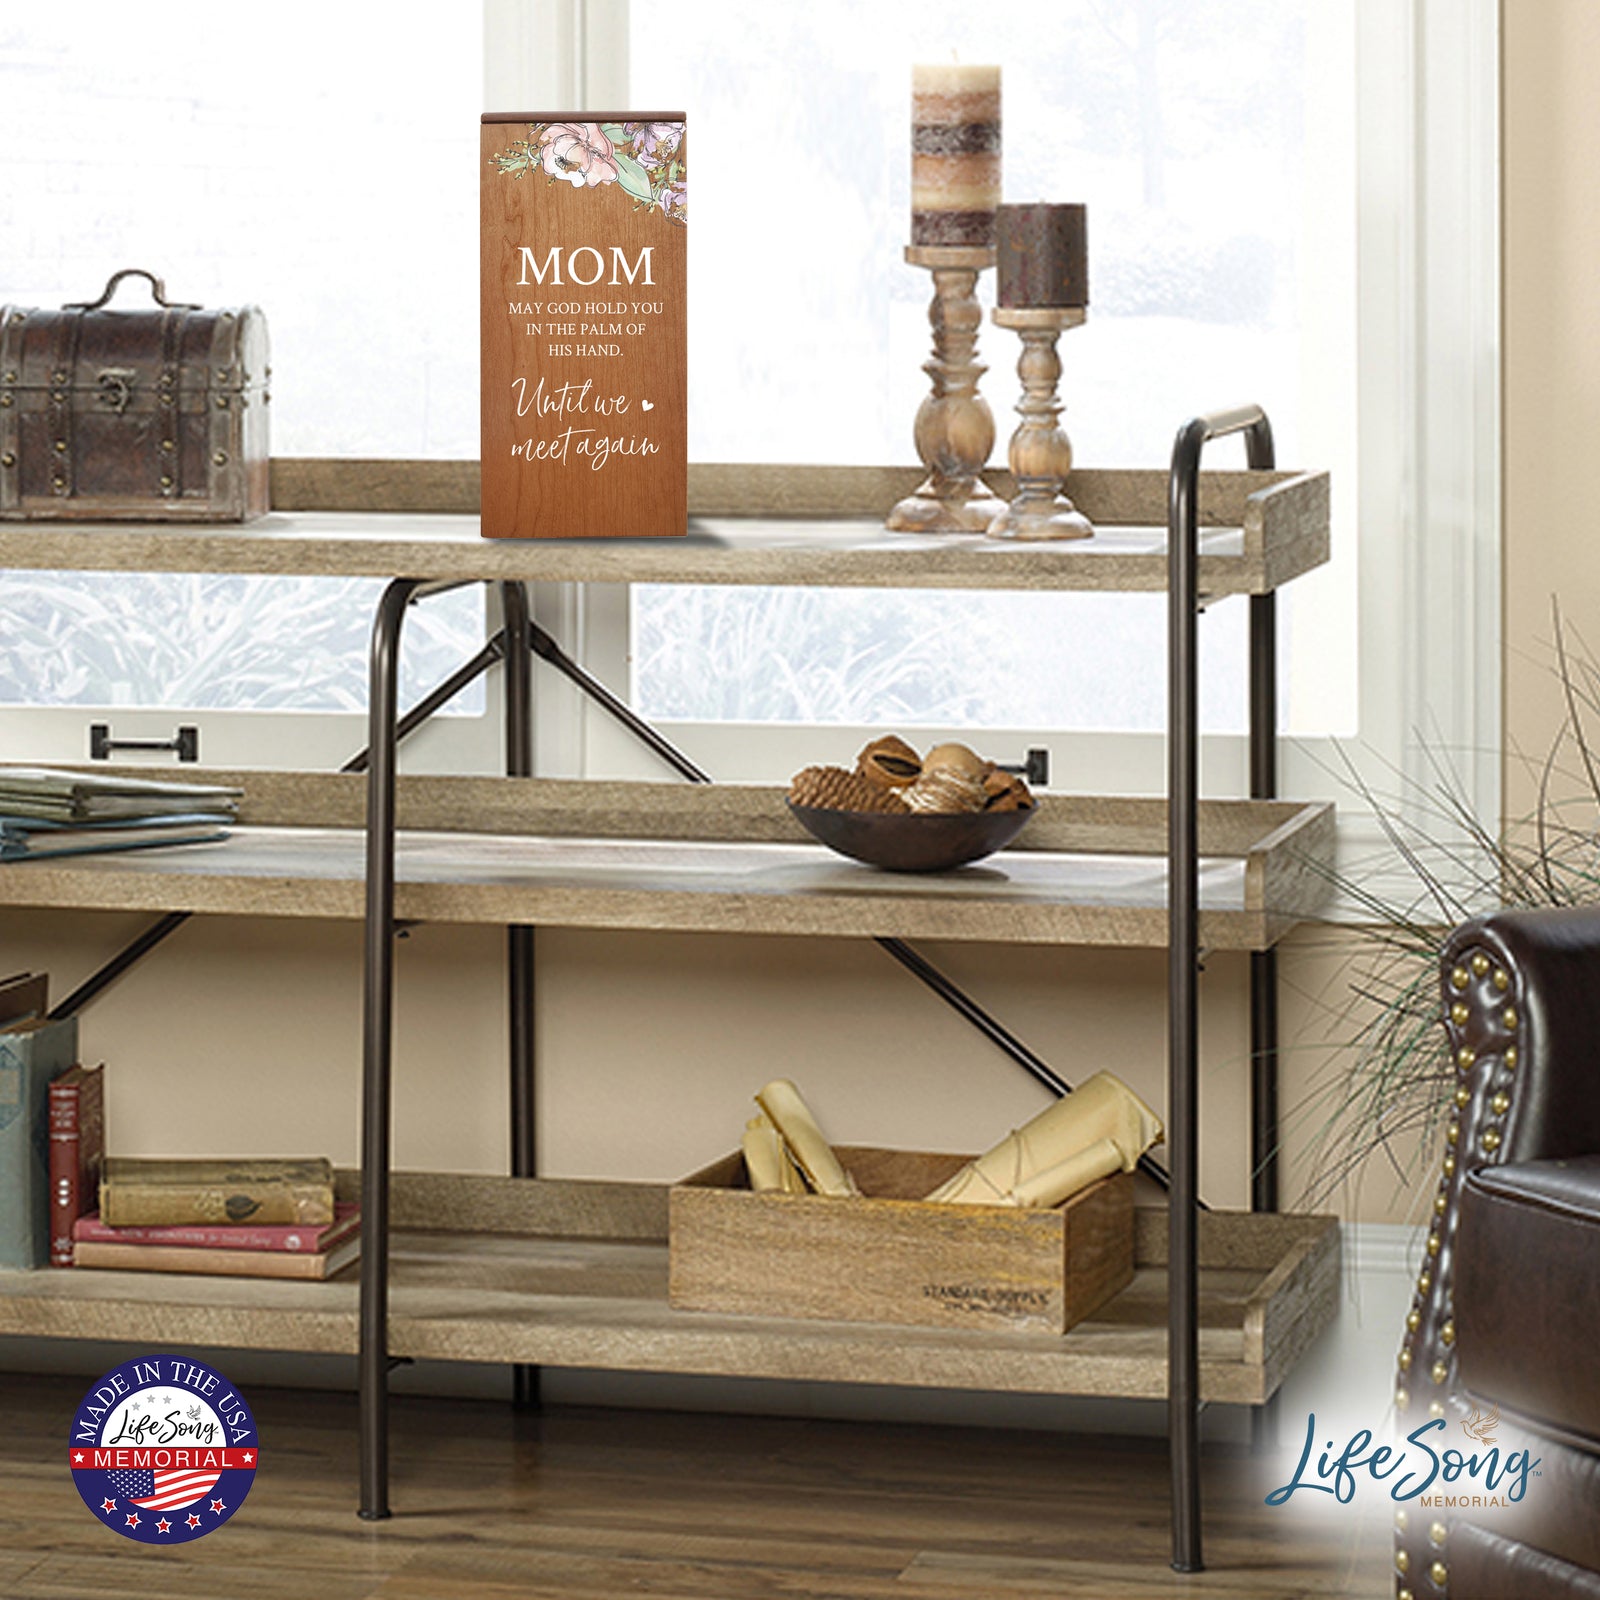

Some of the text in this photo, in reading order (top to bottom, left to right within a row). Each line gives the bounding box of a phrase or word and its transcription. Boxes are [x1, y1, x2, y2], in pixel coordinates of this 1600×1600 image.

[516, 246, 656, 286] MOM
[508, 302, 664, 315] MAY GOD HOLD YOU
[526, 323, 646, 336] IN THE PALM OF
[548, 344, 624, 357] HIS HAND.
[511, 377, 633, 421] Until we
[511, 426, 660, 471] meet again
